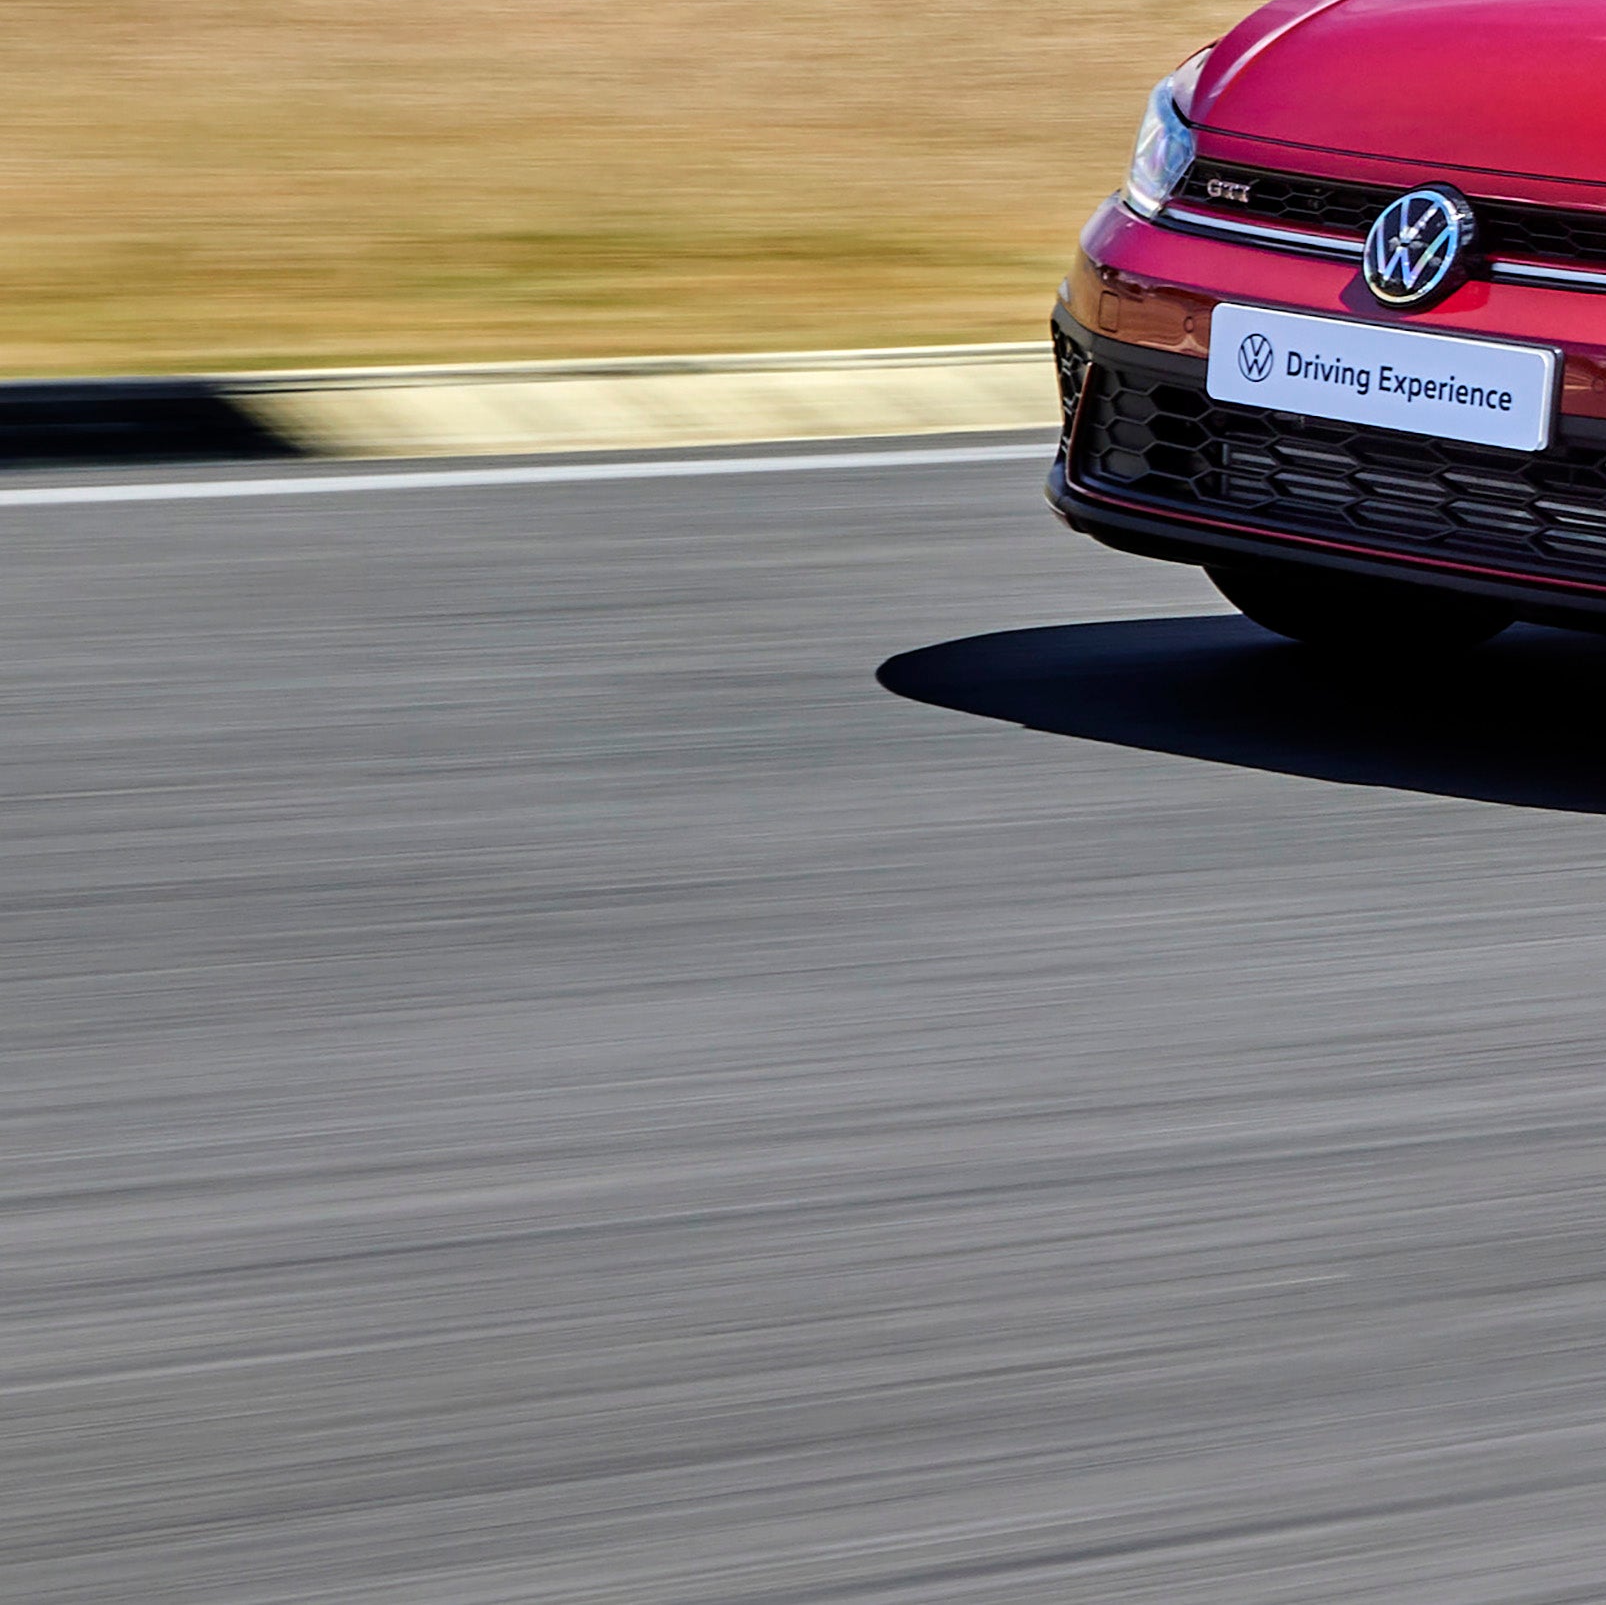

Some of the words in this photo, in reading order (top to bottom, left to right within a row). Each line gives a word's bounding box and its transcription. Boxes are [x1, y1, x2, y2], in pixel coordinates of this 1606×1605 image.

[1207, 178, 1250, 203] GTI
[1286, 351, 1370, 395] Driving
[1378, 366, 1512, 411] Experience
